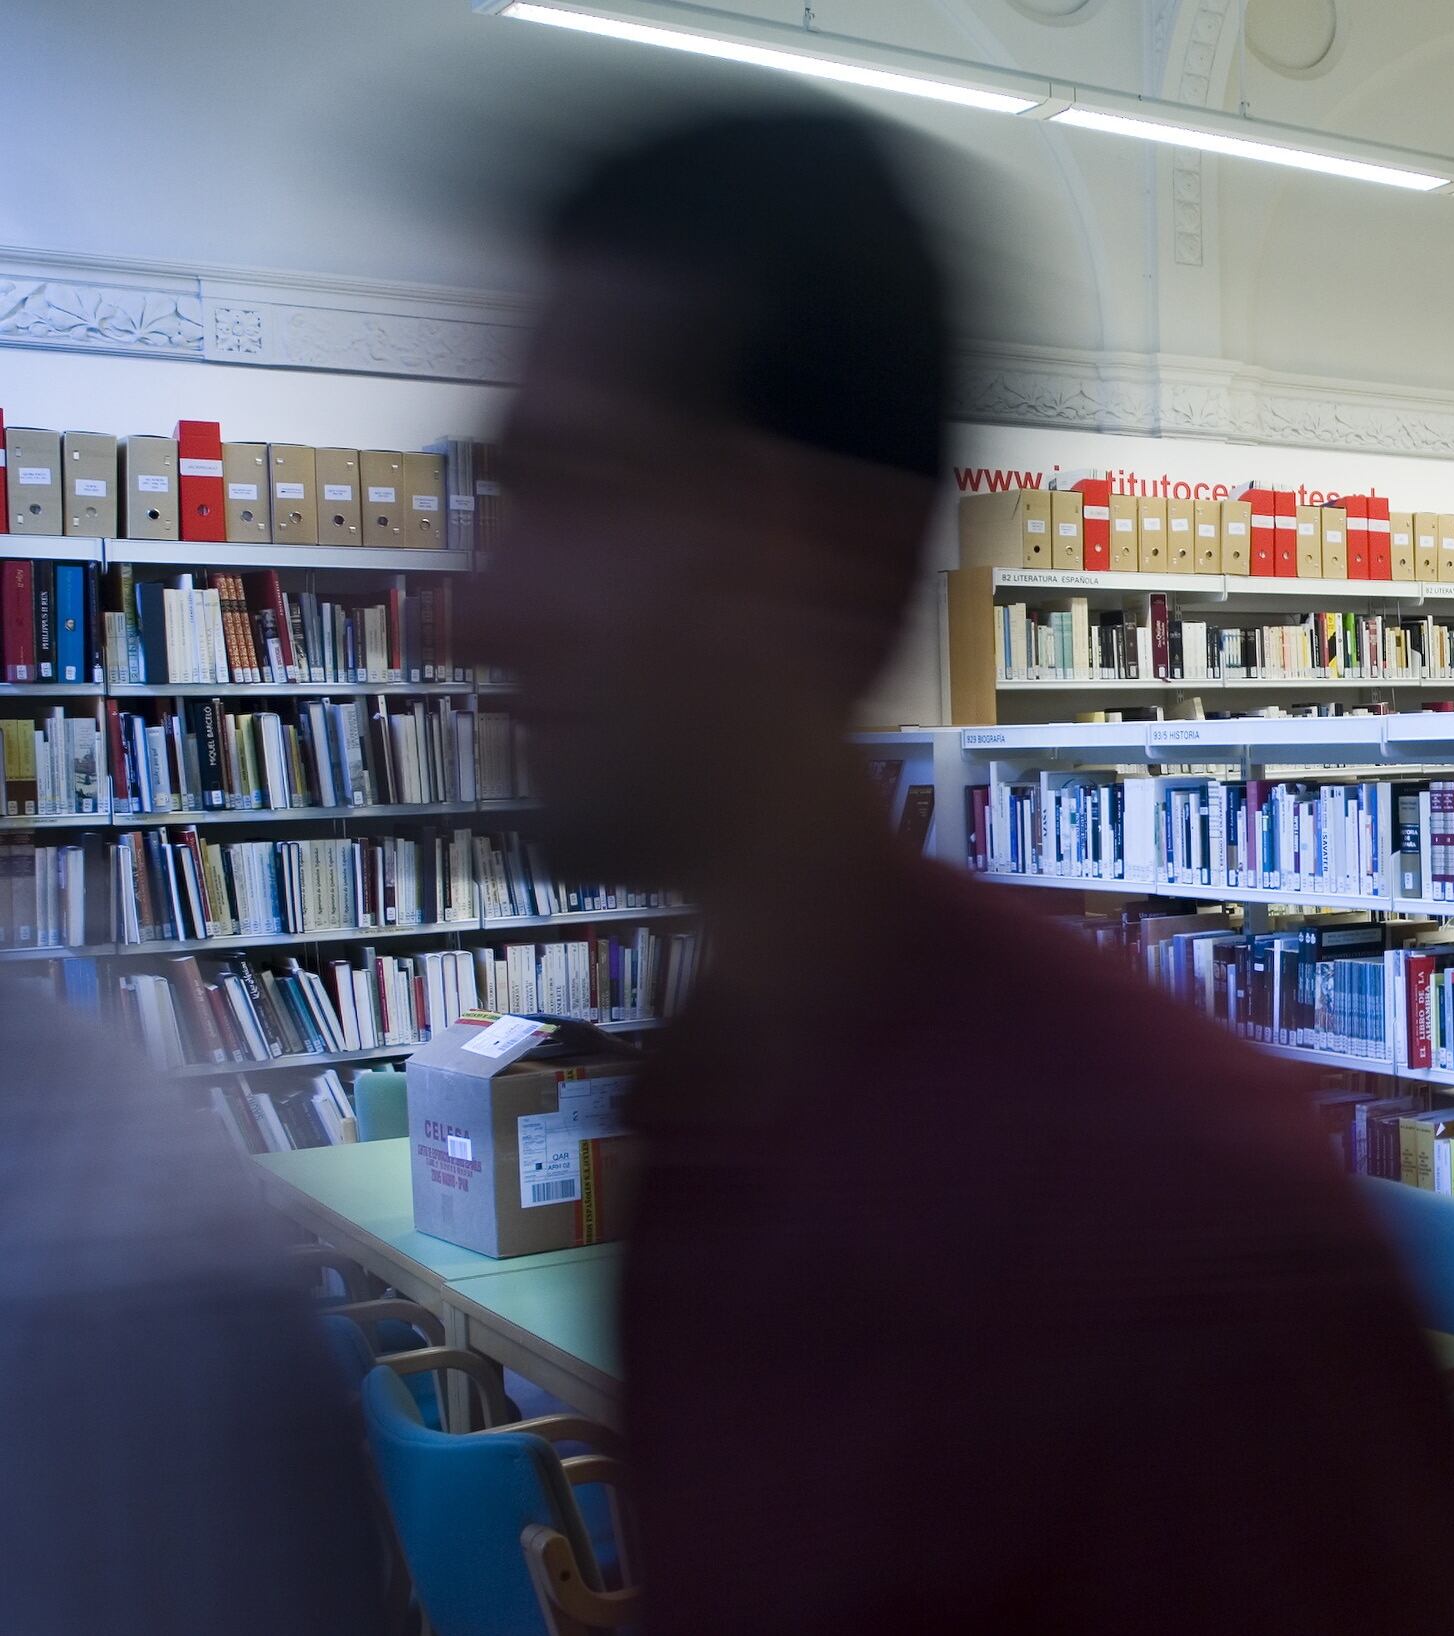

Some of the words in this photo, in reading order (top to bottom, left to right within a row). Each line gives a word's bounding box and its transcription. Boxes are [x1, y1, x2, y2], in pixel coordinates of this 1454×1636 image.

[1002, 574, 1011, 582] 82
[1013, 574, 1057, 583] LITERATURA
[1061, 575, 1099, 585] ESPAÑOLA
[1169, 730, 1200, 740] HISTORIA
[1418, 971, 1424, 984] LA
[1418, 990, 1425, 1004] DE
[1424, 985, 1432, 1041] ALHAMBRA
[1418, 1010, 1426, 1040] LIBRO
[1419, 1045, 1426, 1058] EL
[552, 1152, 569, 1162] QAR
